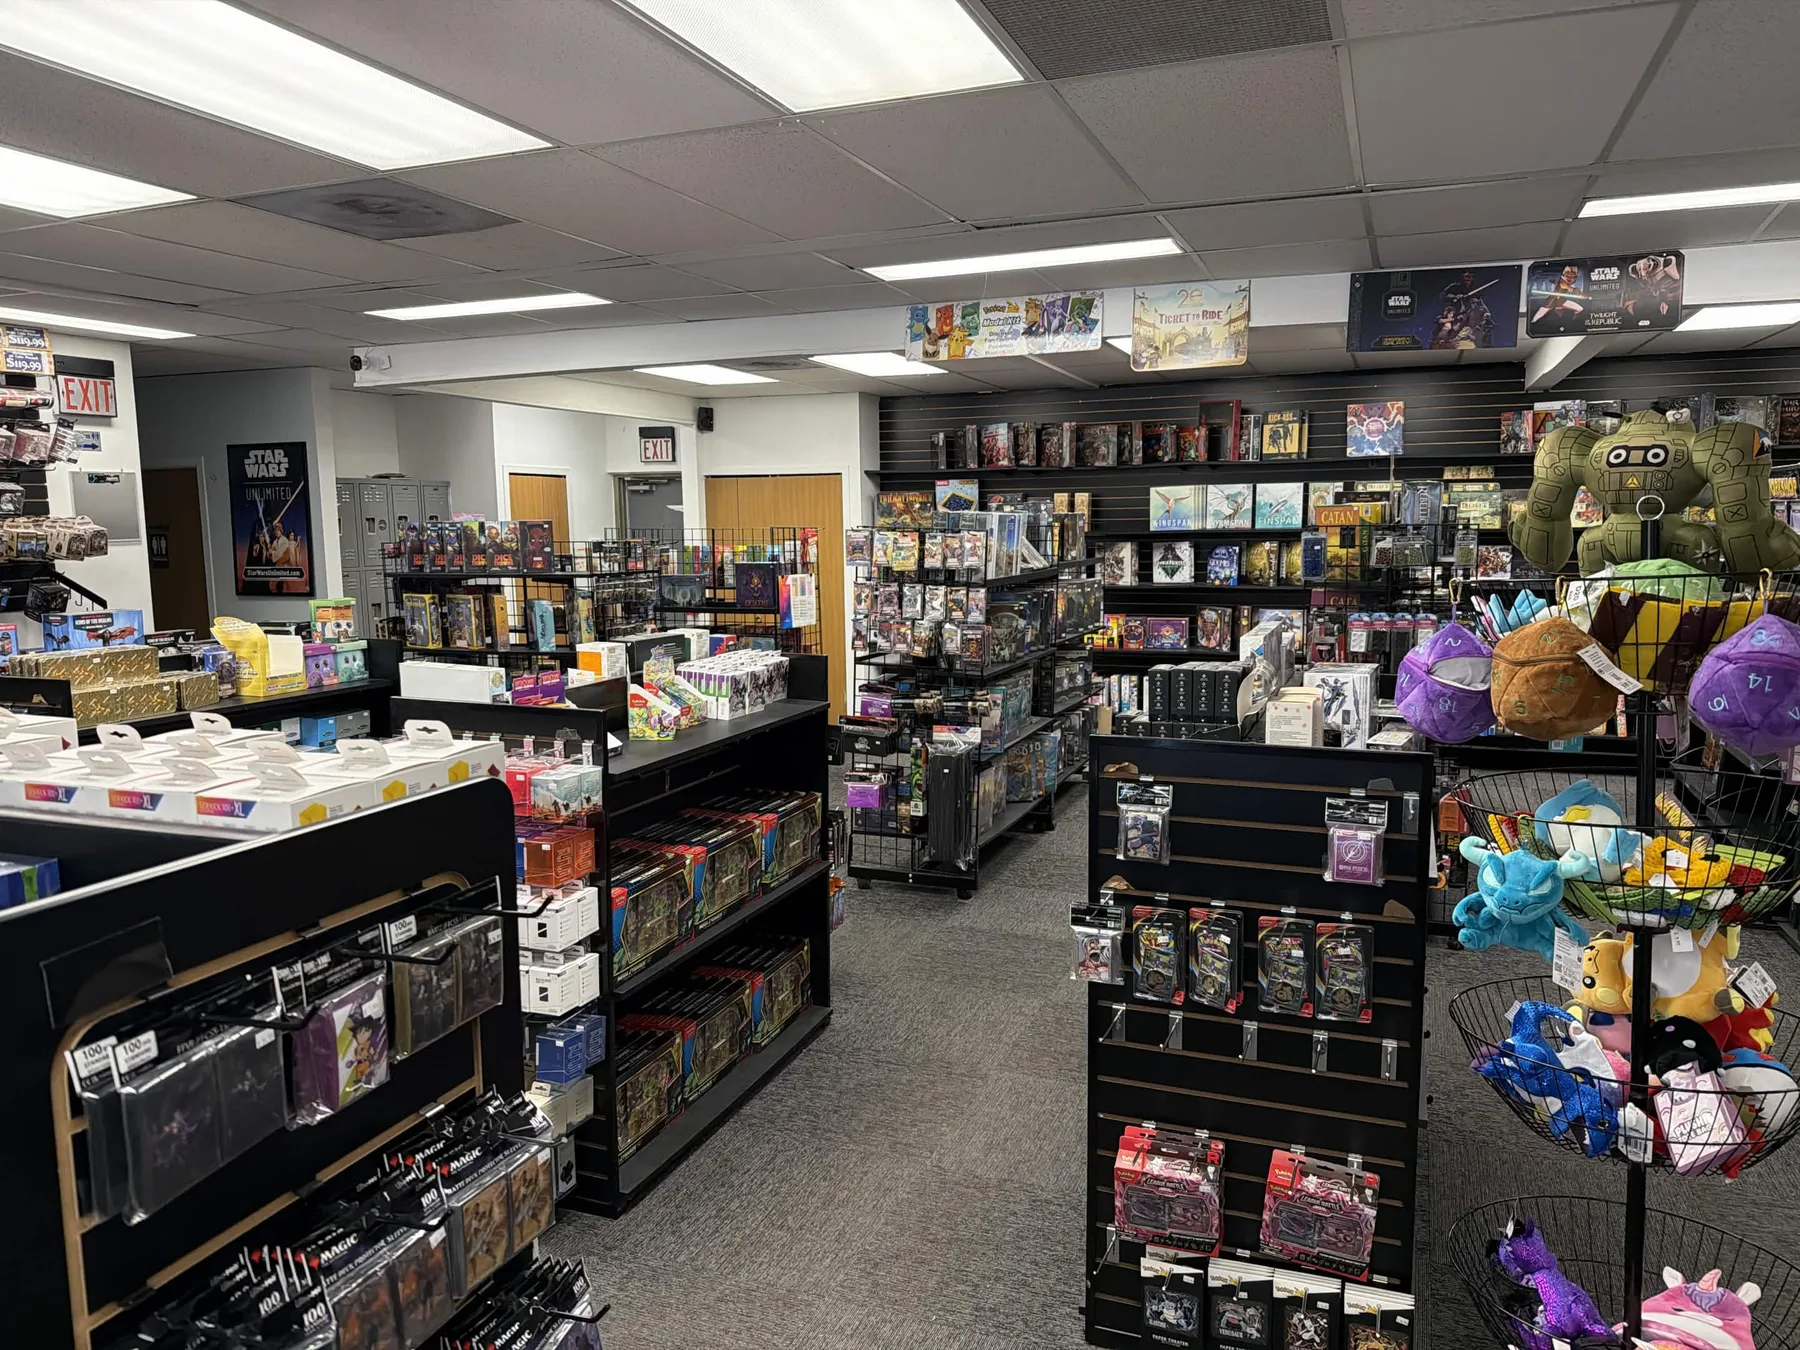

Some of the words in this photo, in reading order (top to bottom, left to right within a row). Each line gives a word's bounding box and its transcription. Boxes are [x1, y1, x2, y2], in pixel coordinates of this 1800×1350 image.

[1590, 267, 1620, 275] STAR
[1591, 273, 1618, 281] WARS
[1589, 283, 1620, 291] UNLIMITED
[982, 318, 1006, 328] Model
[1006, 315, 1021, 325] Kit
[1158, 313, 1190, 325] TICKET
[1202, 310, 1223, 321] RIDE
[9, 334, 45, 348] $119.99
[6, 358, 42, 371] $119.99
[63, 377, 112, 413] EXIT
[1268, 412, 1293, 422] KICK-ASS
[244, 449, 288, 464] STAR
[643, 439, 670, 460] EXIT
[245, 463, 289, 478] WARS
[245, 487, 292, 501] UNLIMITED
[1152, 518, 1193, 527] WINGSPAN
[1321, 511, 1354, 525] CATAN
[1748, 672, 1773, 693] 14
[58, 788, 68, 801] XL
[143, 794, 153, 809] XL
[234, 801, 245, 816] XL
[395, 921, 408, 932] 100
[82, 1042, 101, 1060] 100
[122, 1039, 141, 1056] 100
[415, 1140, 446, 1162] MAGIC
[1207, 1151, 1219, 1165] R
[450, 1147, 483, 1172] MAGIC
[1364, 1174, 1378, 1188] R
[420, 1188, 438, 1207] 100
[320, 1233, 359, 1264] MAGIC
[258, 1291, 281, 1317] 100
[302, 1302, 327, 1327] 100
[494, 1322, 520, 1349] MAGIC
[511, 1329, 533, 1350] AGIC
[1152, 1334, 1169, 1342] PAPER
[1168, 1337, 1189, 1346] THEATER
[1218, 1328, 1243, 1339] VENUSAUR
